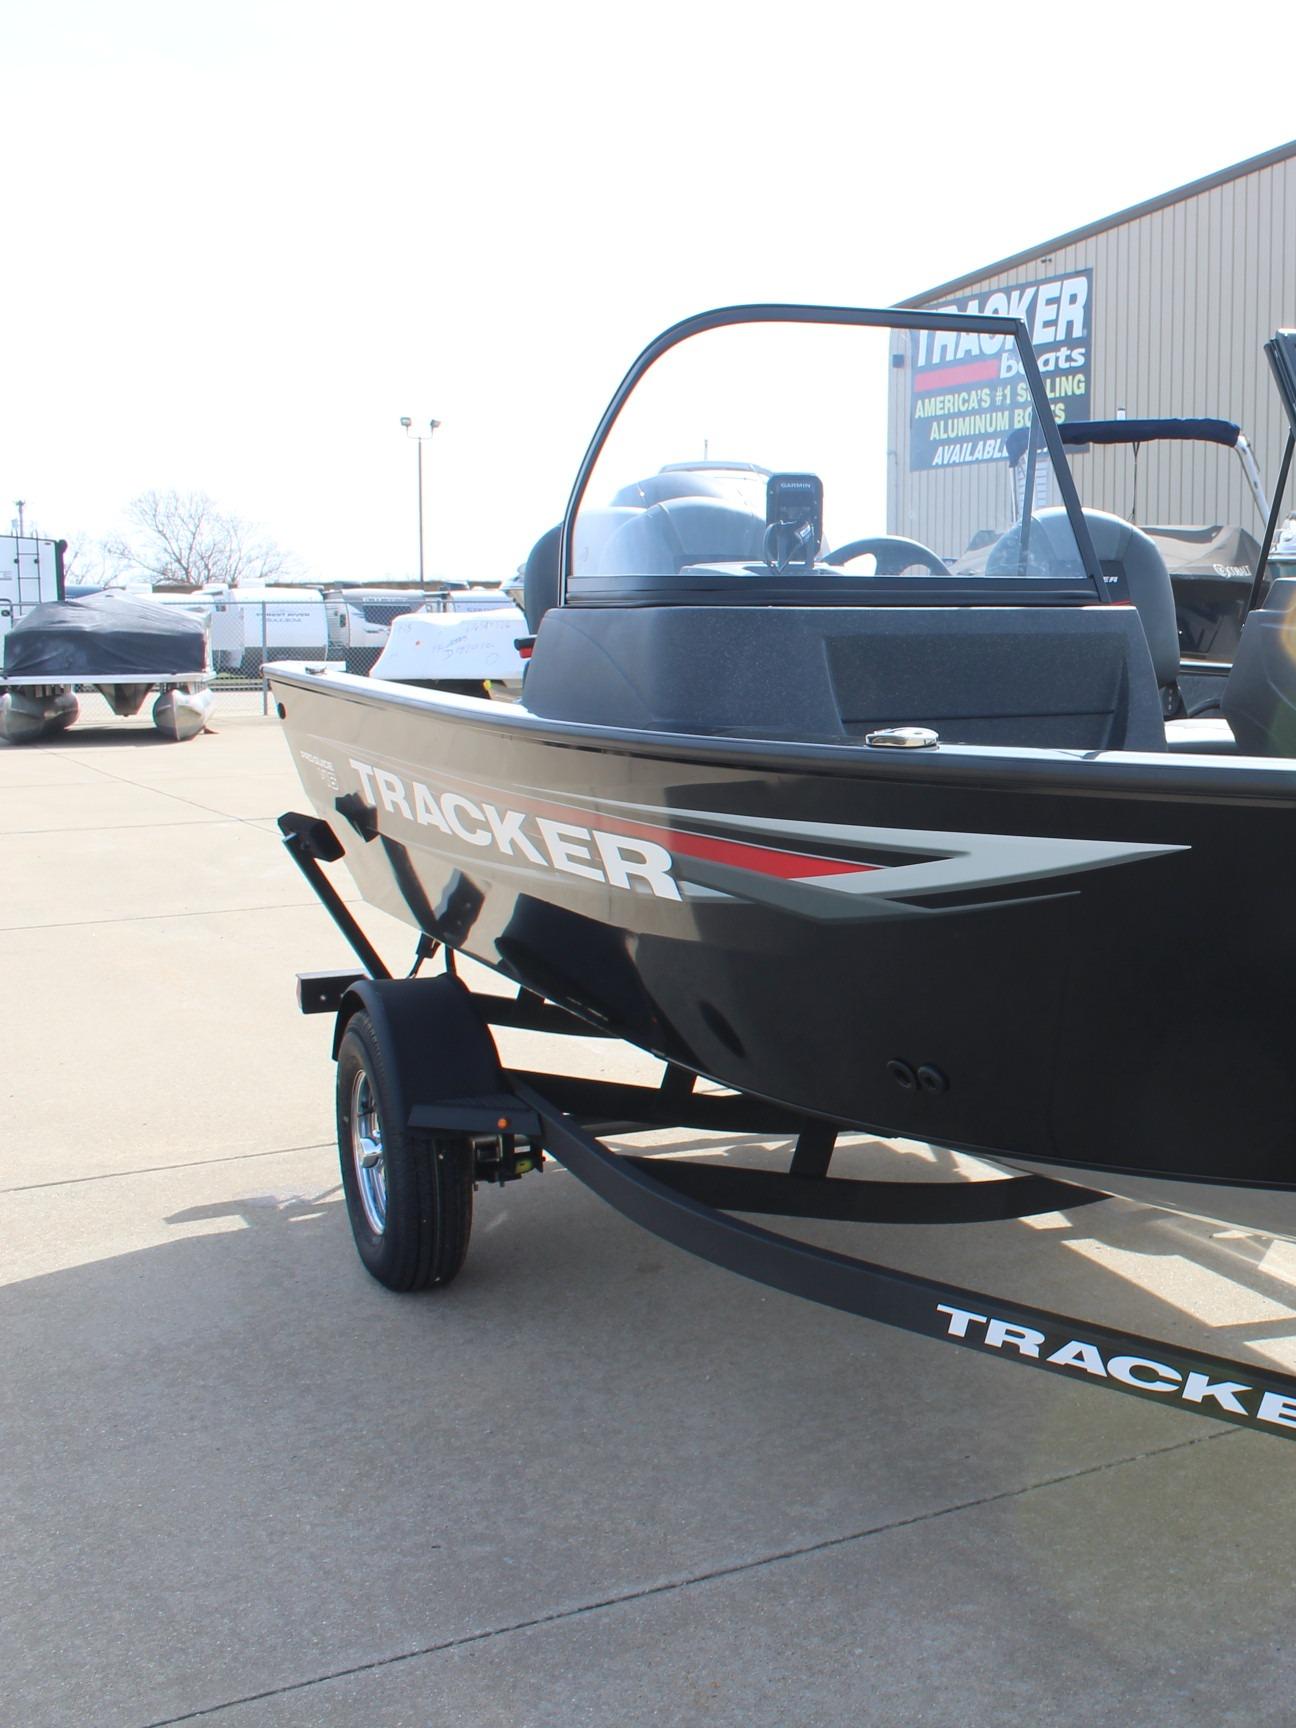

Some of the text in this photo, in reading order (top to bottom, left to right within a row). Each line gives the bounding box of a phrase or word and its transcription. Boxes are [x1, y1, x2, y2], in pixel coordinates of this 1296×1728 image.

[915, 374, 1085, 418] AMERICA'S #1 SLING
[930, 403, 1066, 440] ALUMINUM BOS
[349, 758, 684, 901] TRACKER
